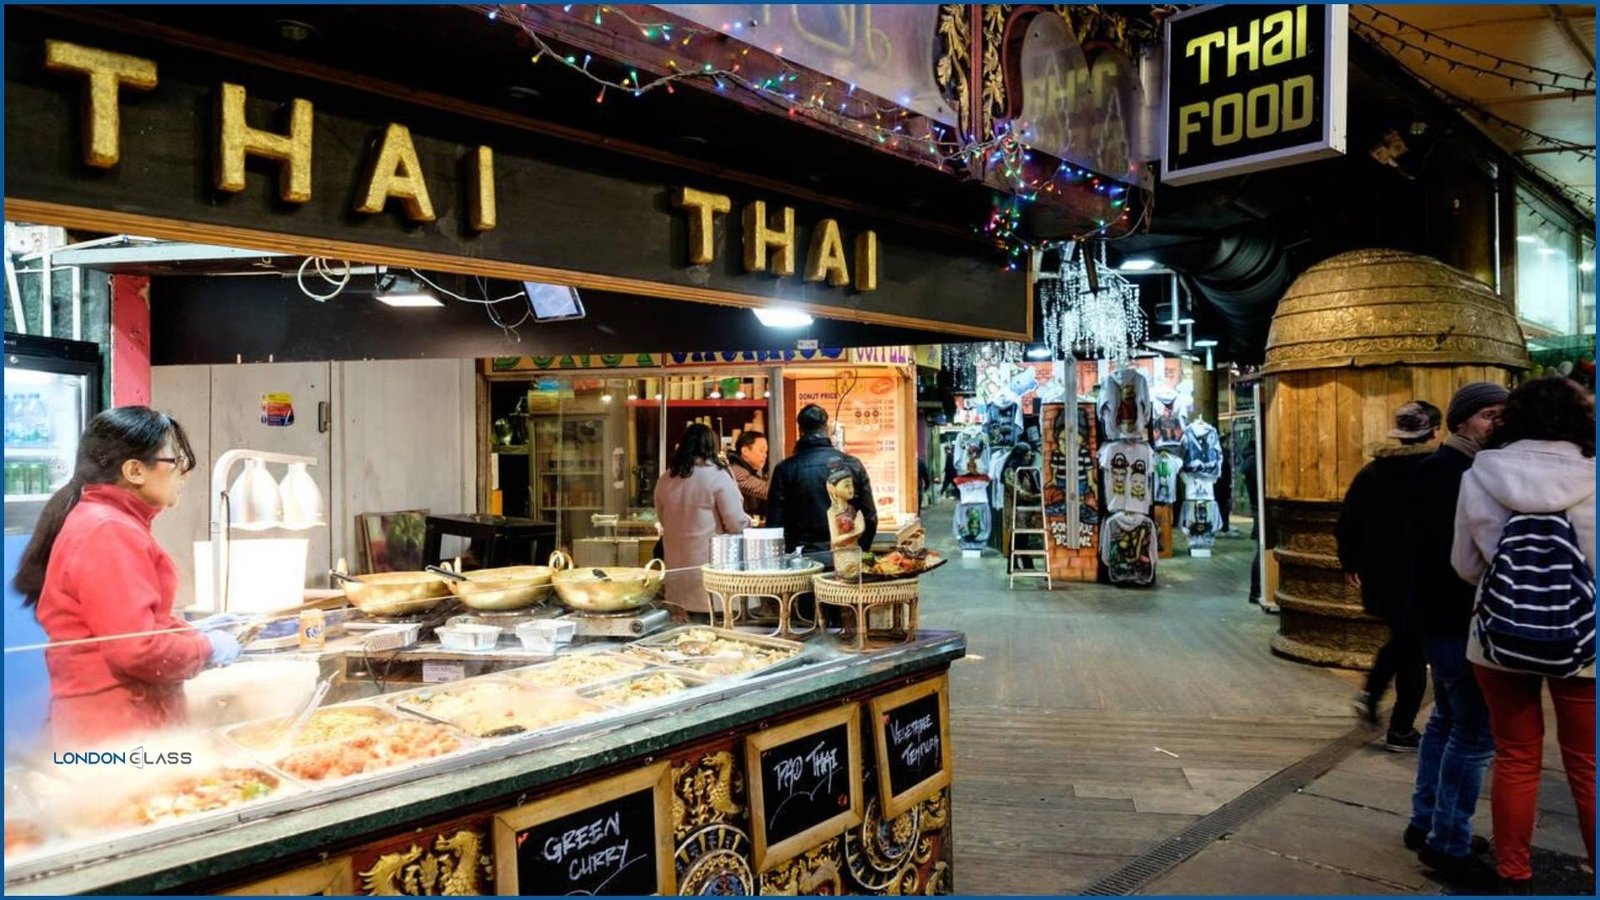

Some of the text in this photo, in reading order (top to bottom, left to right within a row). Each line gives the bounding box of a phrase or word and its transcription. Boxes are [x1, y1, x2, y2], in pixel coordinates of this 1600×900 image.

[1178, 74, 1314, 156] FOOD
[44, 38, 877, 291] THAI THAI
[805, 740, 839, 795] THAI
[543, 810, 621, 864] GREEN
[568, 838, 630, 881] CURRY
